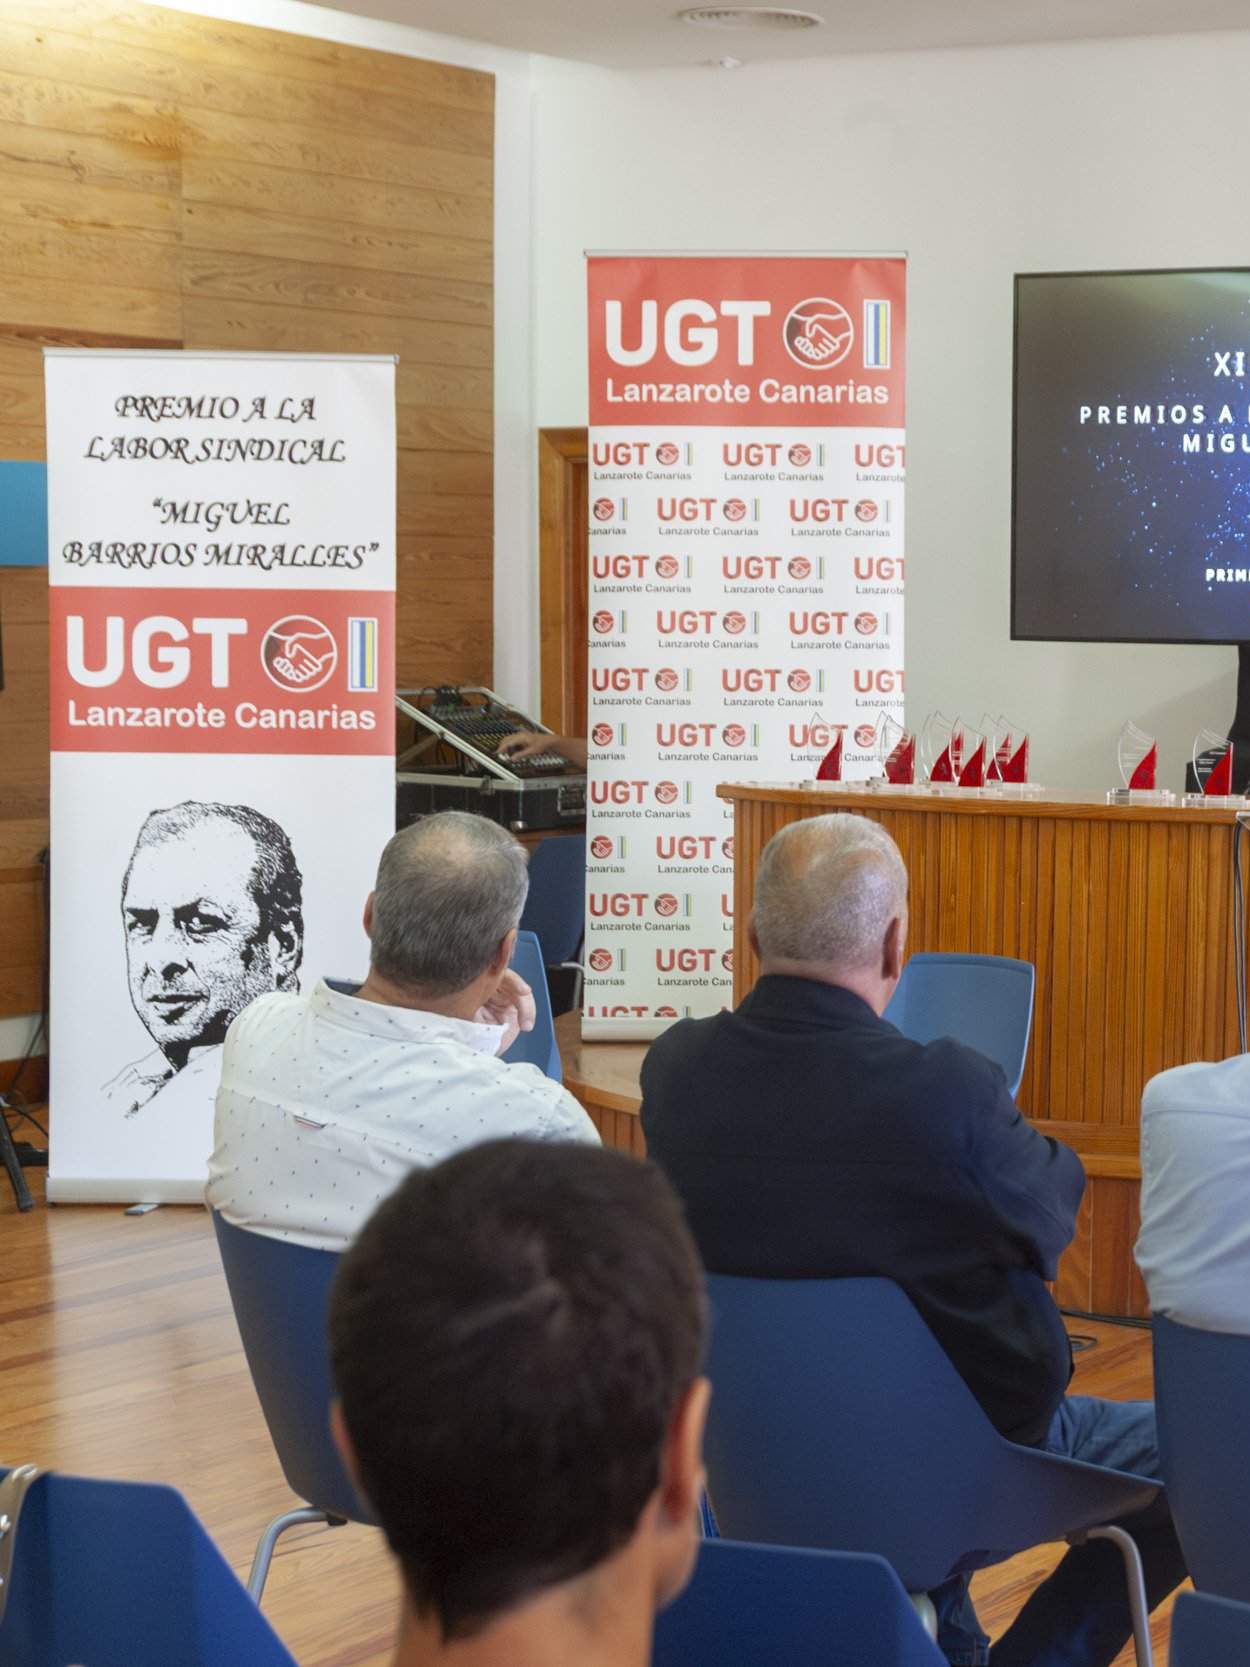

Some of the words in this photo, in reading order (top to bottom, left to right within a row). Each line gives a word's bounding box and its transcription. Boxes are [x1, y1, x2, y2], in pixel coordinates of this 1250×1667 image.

[605, 299, 771, 367] UGT
[1214, 352, 1245, 376] XI
[607, 378, 750, 402] Lanzarote
[759, 380, 888, 404] Canarias
[115, 396, 239, 422] PREMIO
[242, 396, 269, 423] A
[275, 396, 317, 421] LA
[1080, 404, 1205, 425] PREMIOS
[1219, 404, 1234, 424] A
[83, 436, 196, 464] LABOR
[193, 437, 345, 464] SINDICAL
[593, 443, 650, 466] UGT
[723, 443, 783, 467] UGT
[594, 472, 643, 480] Lanzarote
[646, 472, 691, 480] Canarias
[724, 472, 775, 481] Lanzarote
[778, 472, 824, 481] Canarias
[657, 497, 717, 521] UGT
[790, 499, 849, 522] UGT
[659, 528, 710, 536] Lanzarote
[713, 528, 758, 536] Canarias
[792, 528, 842, 536] Lanzarote
[845, 528, 890, 537] Canarias
[62, 541, 196, 569] BARRIOS
[593, 555, 649, 578] UGT
[722, 556, 782, 579] UGT
[594, 584, 642, 592] Lanzarote
[645, 584, 691, 593] Canarias
[724, 585, 775, 594] Lanzarote
[778, 585, 823, 594] Canarias
[657, 610, 717, 634] UGT
[789, 612, 848, 635] UGT
[66, 615, 248, 689] UGT
[658, 640, 709, 648] Lanzarote
[713, 640, 759, 648] Canarias
[791, 640, 841, 649] Lanzarote
[844, 640, 890, 649] Canarias
[592, 668, 649, 691] UGT
[722, 669, 782, 692] UGT
[593, 697, 642, 705] Lanzarote
[645, 697, 691, 705] Canarias
[724, 698, 774, 707] Lanzarote
[778, 699, 823, 707] Canarias
[69, 700, 226, 728] Lanzarote
[235, 702, 376, 730] Canarias
[657, 723, 717, 746] UGT
[658, 752, 709, 761] Lanzarote
[712, 752, 758, 761] Canarias
[591, 781, 648, 804] UGT
[592, 810, 641, 818] Lanzarote
[645, 810, 690, 818] Canarias
[656, 836, 716, 859] UGT
[658, 865, 709, 873] Lanzarote
[590, 893, 648, 917] UGT
[591, 922, 641, 931] Lanzarote
[645, 922, 690, 931] Canarias
[656, 948, 716, 972] UGT
[658, 977, 708, 986] Lanzarote
